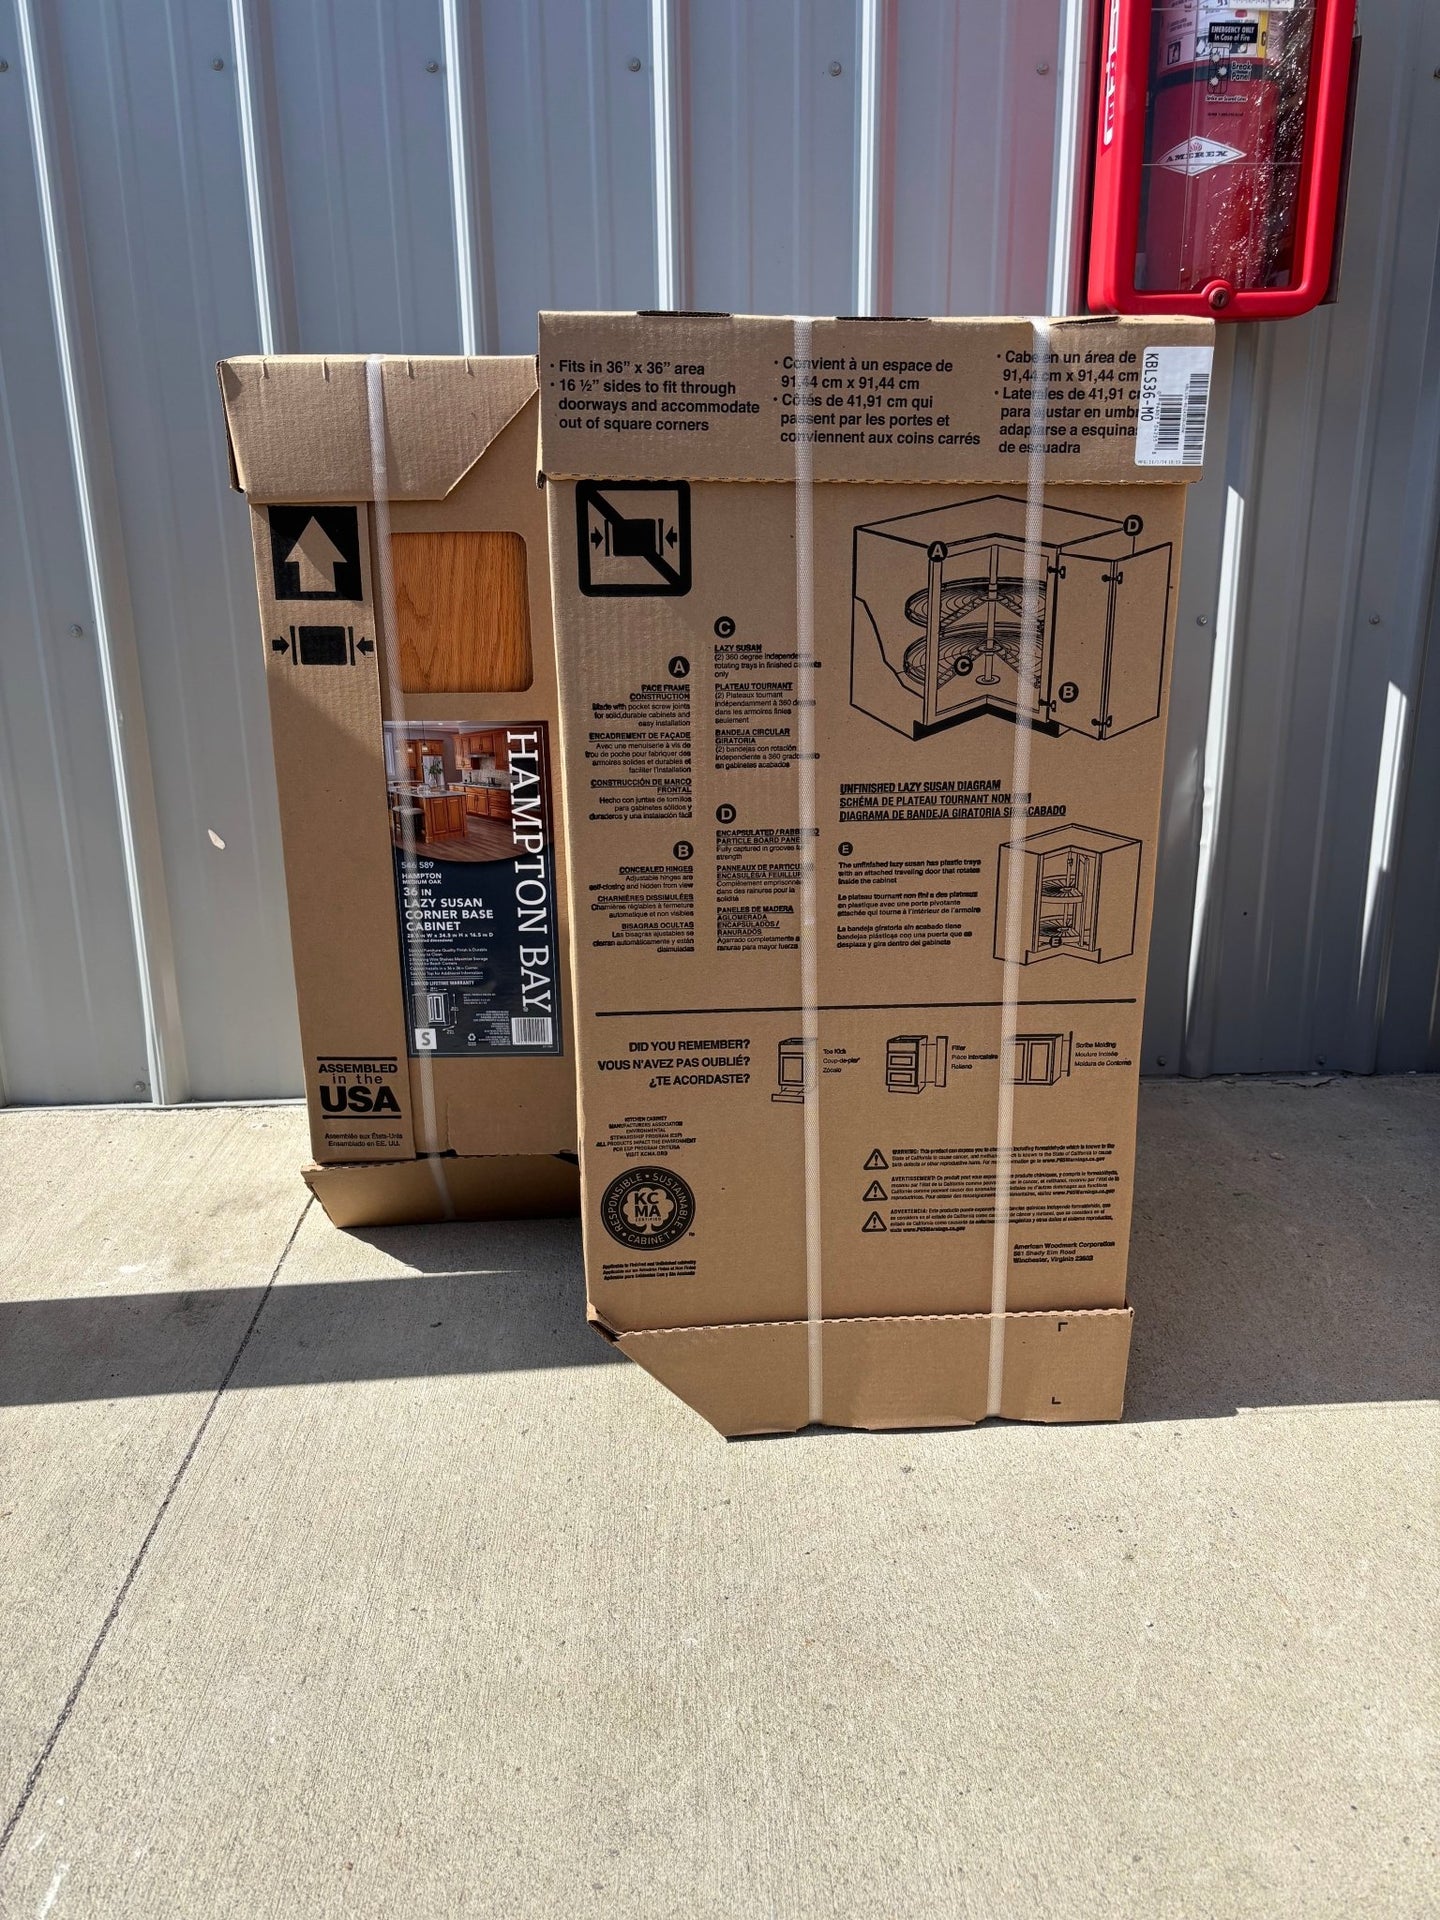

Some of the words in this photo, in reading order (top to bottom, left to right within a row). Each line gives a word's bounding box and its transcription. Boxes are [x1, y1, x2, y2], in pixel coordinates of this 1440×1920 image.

[1211, 25, 1240, 33] EMERGENCY
[1240, 34, 1251, 42] Fire
[1166, 150, 1229, 162] AMEREX
[1063, 353, 1080, 364] un
[1084, 350, 1115, 364] área
[1118, 350, 1137, 364] de
[559, 359, 585, 373] Fits
[589, 360, 602, 373] in
[634, 363, 643, 374] x
[674, 364, 705, 376] area
[849, 356, 857, 370] à
[861, 360, 878, 371] un
[882, 360, 932, 374] espace
[935, 359, 953, 372] de
[1065, 371, 1074, 382] x
[1078, 369, 1114, 384] 91,44
[1118, 371, 1139, 382] cm
[559, 378, 576, 392] 16
[603, 379, 641, 393] sides
[644, 380, 659, 393] to
[663, 380, 677, 394] fit
[681, 380, 736, 398] through
[822, 378, 842, 389] cm
[846, 379, 855, 389] x
[858, 376, 895, 391] 91,44
[898, 379, 920, 390] cm
[1068, 387, 1086, 400] de
[1088, 387, 1123, 402] 41,91
[558, 397, 627, 414] doorways
[631, 399, 657, 412] and
[661, 400, 760, 414] accommodate
[826, 394, 844, 407] de
[847, 394, 882, 409] 41,91
[886, 397, 908, 408] cm
[911, 395, 933, 411] qui
[1000, 407, 1031, 420] para
[1084, 408, 1100, 418] en
[558, 417, 582, 429] out
[585, 416, 600, 429] of
[603, 419, 652, 433] square
[655, 420, 710, 432] corners
[839, 414, 862, 428] par
[865, 413, 885, 425] les
[889, 414, 933, 429] portes
[936, 414, 950, 427] et
[1069, 426, 1078, 436] a
[868, 433, 893, 444] aux
[896, 431, 935, 445] coins
[937, 432, 981, 446] carrés
[998, 441, 1016, 453] de
[714, 644, 735, 652] LAZY
[735, 644, 762, 652] SUSAN
[641, 684, 662, 692] FACE
[664, 684, 690, 692] FRAME
[751, 682, 793, 690] TOURNANT
[629, 692, 690, 700] CONSTRUCTION
[589, 732, 647, 740] ENCADREMENT
[660, 732, 691, 741] FAÇADE
[715, 728, 750, 737] BANDEJA
[752, 727, 790, 736] CIRCULAR
[590, 778, 650, 787] CONSTRUCCIÓN
[652, 778, 662, 786] DE
[664, 778, 692, 786] MARCO
[839, 783, 896, 793] UNFINISHED
[897, 782, 922, 792] LAZY
[923, 781, 955, 791] SUSAN
[957, 779, 1001, 790] DIAGRAM
[657, 786, 692, 794] FRONTAL
[839, 796, 879, 807] SCHÉMA
[881, 796, 895, 806] DE
[896, 795, 937, 806] PLATEAU
[940, 794, 989, 804] TOURNANT
[991, 793, 1012, 803] NON
[839, 810, 890, 820] DIAGRAMA
[892, 810, 905, 819] DE
[906, 808, 950, 819] BANDEJA
[951, 807, 1001, 817] GIRATORIA
[506, 730, 548, 935] HAMPTON
[419, 861, 434, 869] 589
[619, 866, 664, 874] CONCEALED
[665, 865, 693, 873] HINGES
[716, 864, 756, 872] PANNEAUX
[838, 861, 851, 869] The
[403, 886, 418, 896] 36
[421, 888, 432, 896] IN
[404, 898, 436, 908] LAZY
[440, 897, 483, 908] SUSAN
[405, 909, 458, 920] CORNER
[461, 909, 494, 919] BASE
[717, 906, 750, 914] PANELES
[406, 921, 461, 932] CABINET
[621, 922, 659, 930] BISAGRAS
[660, 921, 694, 929] OCULTAS
[518, 944, 552, 1013] BAY
[421, 1032, 431, 1046] S
[628, 1042, 649, 1052] DID
[651, 1041, 675, 1051] YOU
[678, 1039, 750, 1050] REMEMBER?
[318, 1063, 398, 1074] ASSEMBLED
[597, 1060, 631, 1071] VOUS
[632, 1058, 673, 1069] N'AVEZ
[676, 1058, 699, 1068] PAS
[701, 1054, 751, 1067] OUBLIÉ?
[332, 1073, 347, 1084] in
[356, 1073, 383, 1084] the
[649, 1076, 671, 1088] ¿TE
[673, 1073, 750, 1085] ACORDASTE?
[319, 1085, 402, 1113] USA
[607, 1172, 643, 1233] RESPONSIBLE
[633, 1191, 660, 1205] KC
[651, 1172, 688, 1229] SUSTAINABLE
[634, 1205, 661, 1218] MA
[627, 1231, 671, 1245] CABINET
